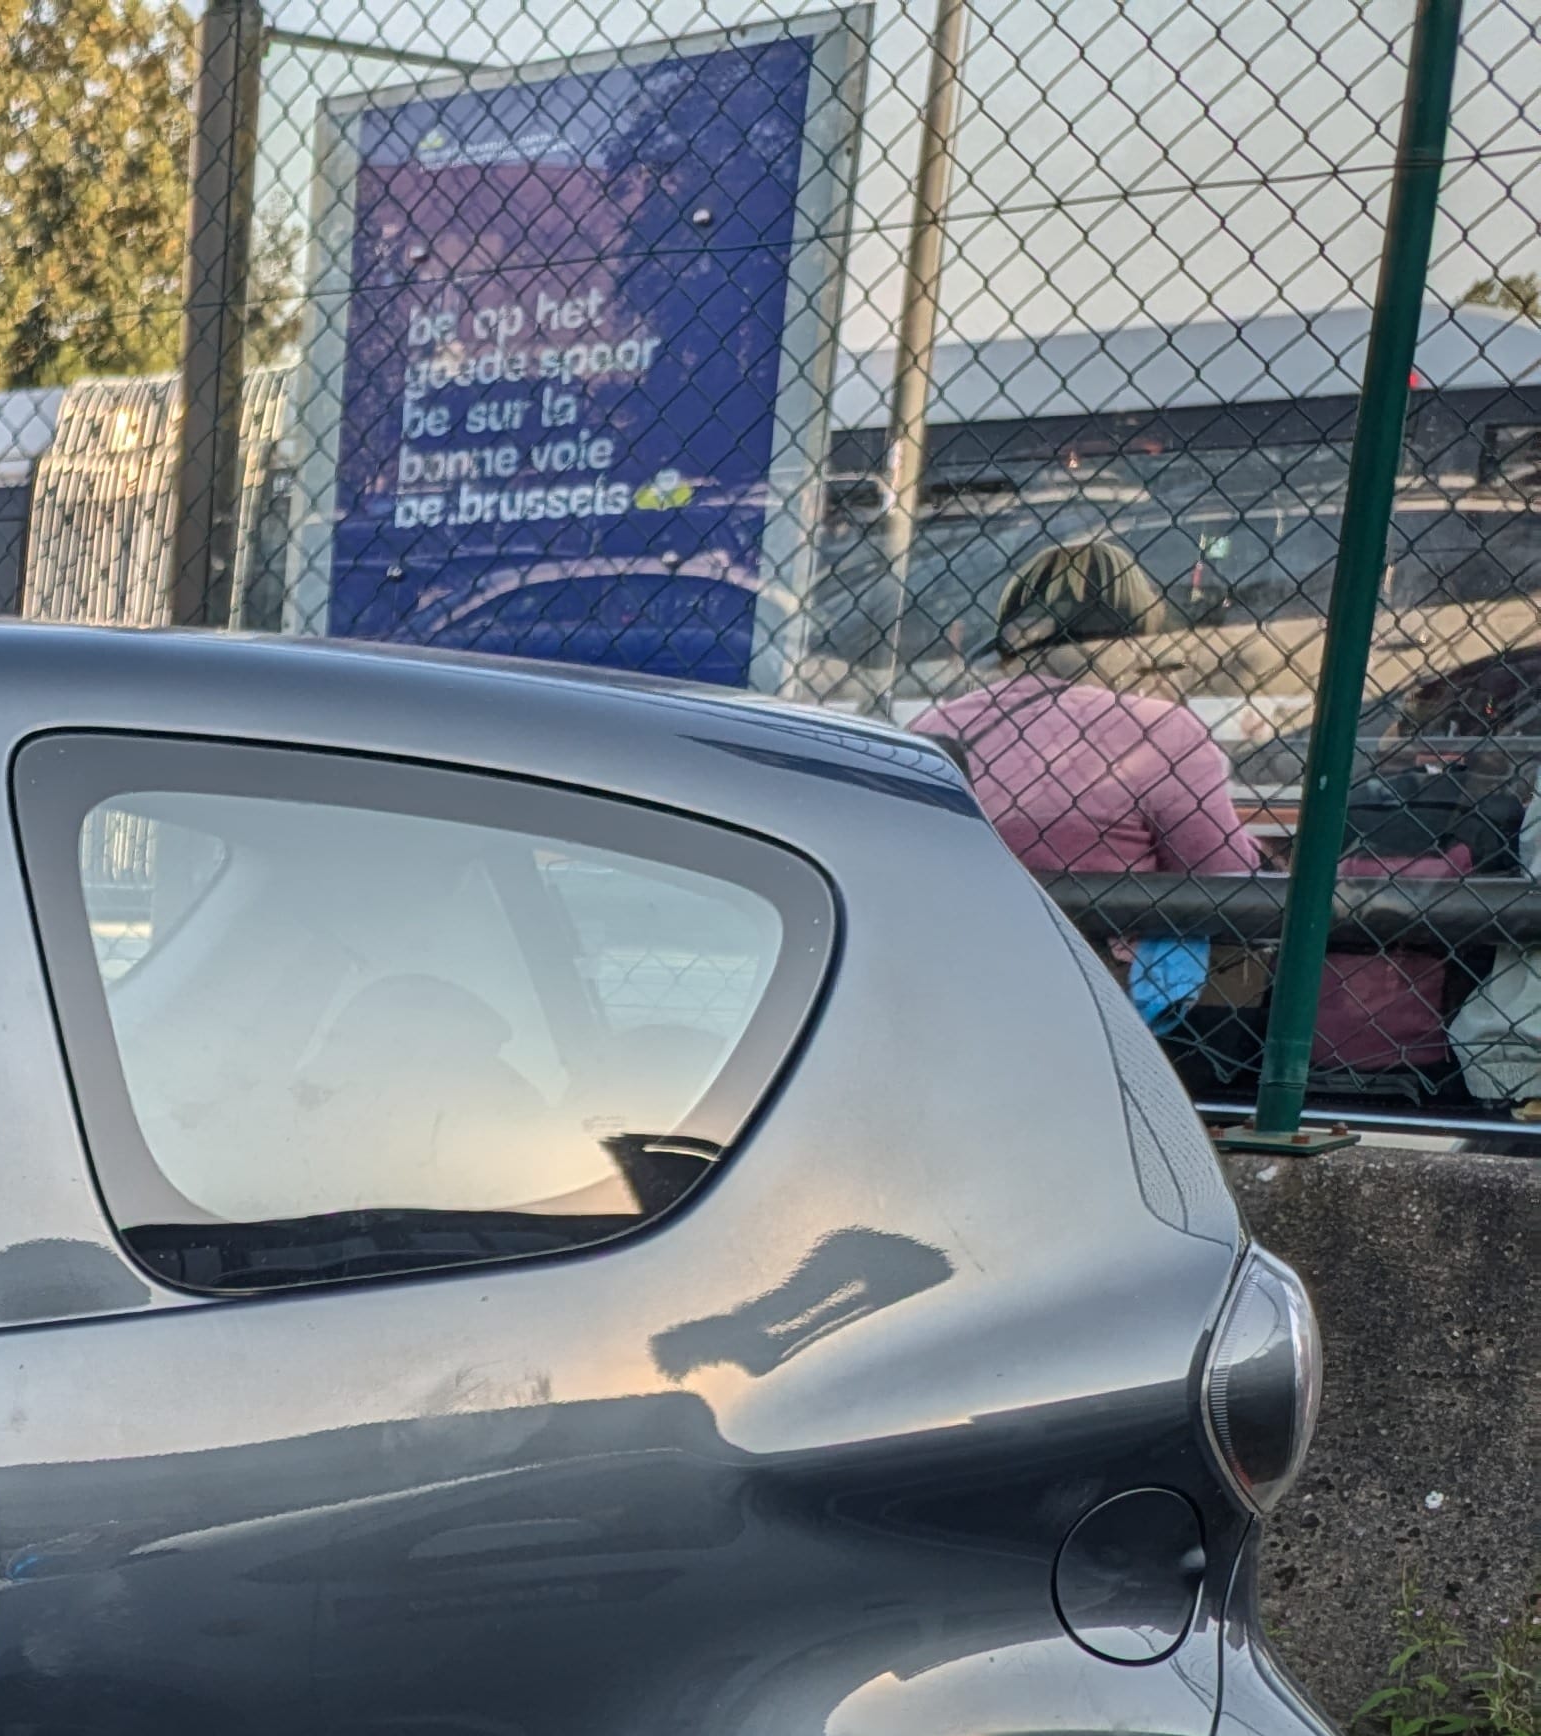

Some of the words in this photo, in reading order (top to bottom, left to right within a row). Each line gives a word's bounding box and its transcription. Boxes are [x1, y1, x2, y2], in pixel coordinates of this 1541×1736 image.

[407, 305, 458, 346] be
[473, 304, 524, 350] op
[536, 287, 606, 332] het
[404, 343, 528, 400] goede
[539, 335, 661, 385] spoor
[401, 398, 452, 439] be
[465, 397, 533, 434] sur
[541, 386, 578, 428] la
[398, 443, 520, 483] bonne
[530, 427, 615, 472] voie
[394, 471, 632, 529] be.brussels
